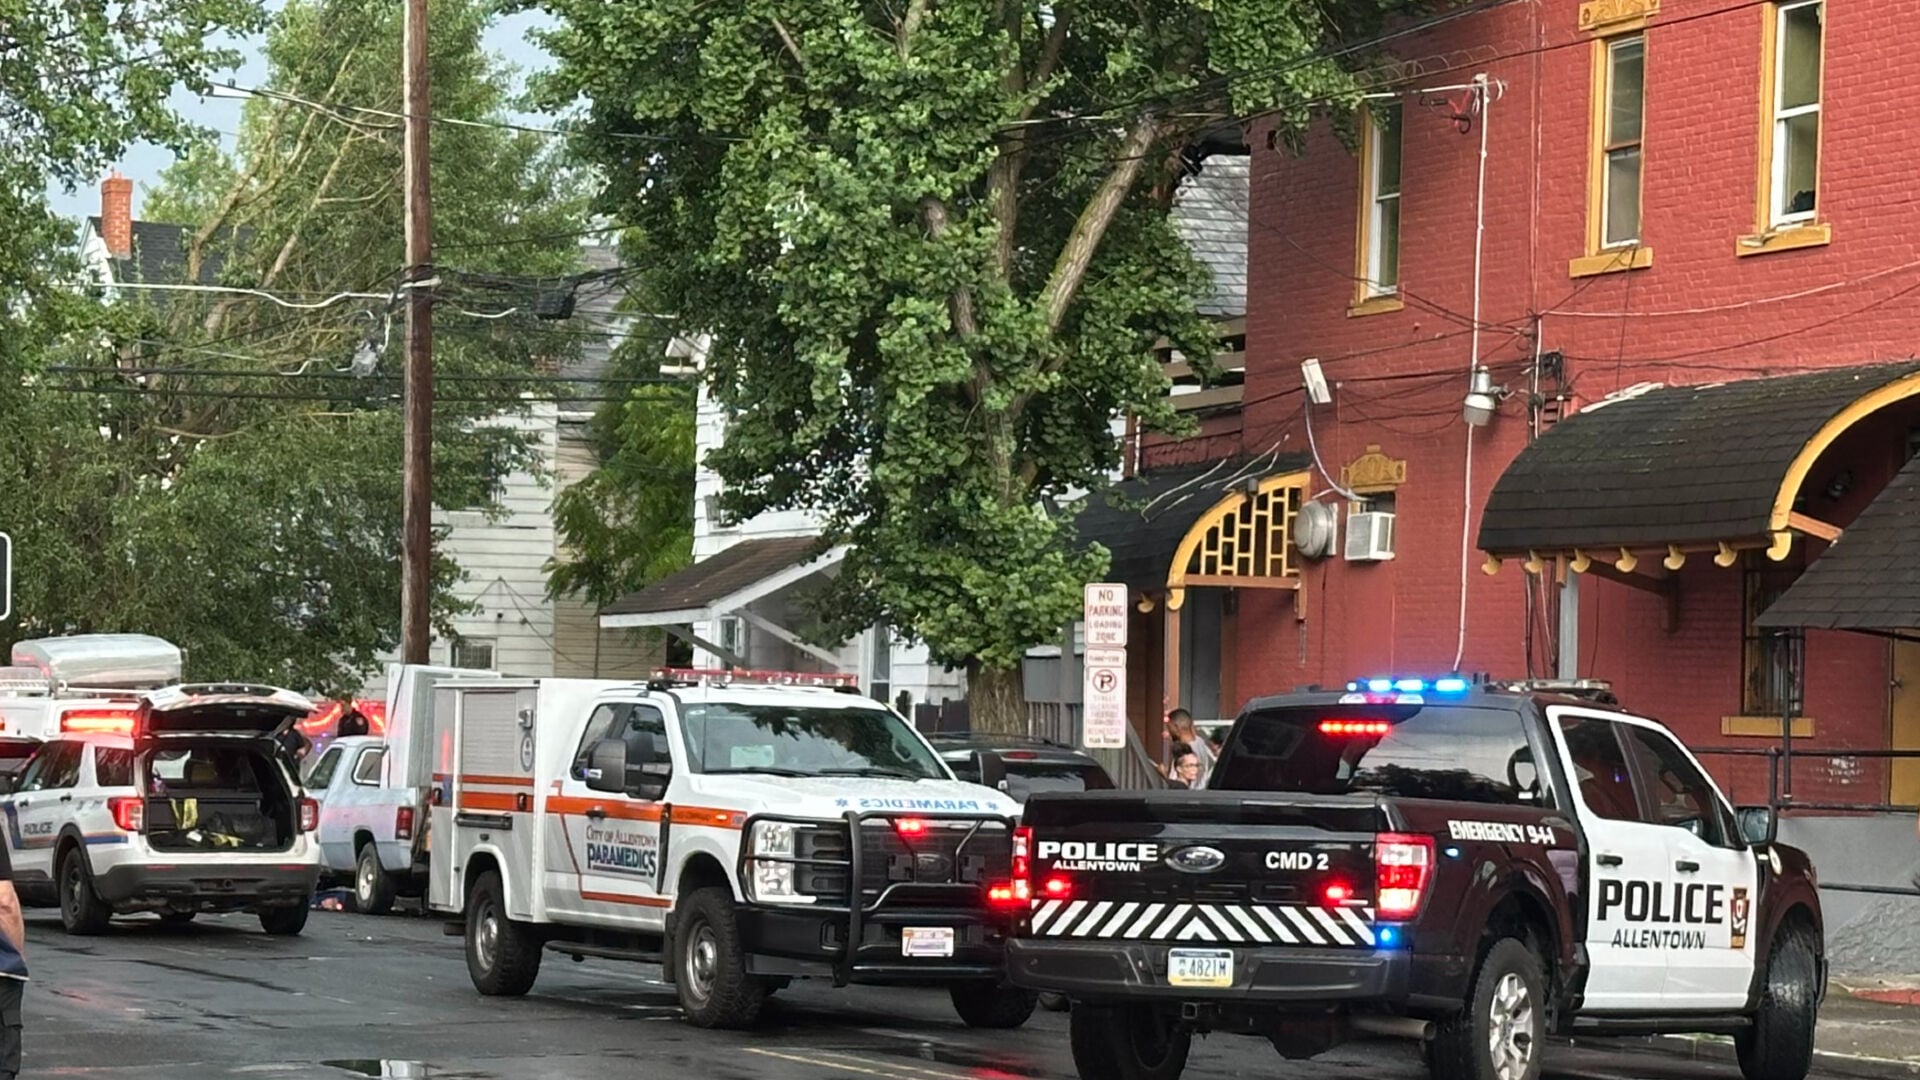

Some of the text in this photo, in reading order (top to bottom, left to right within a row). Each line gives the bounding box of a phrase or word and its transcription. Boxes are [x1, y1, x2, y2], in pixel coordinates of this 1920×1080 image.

[1098, 589, 1114, 602] NO
[1088, 604, 1124, 617] PARKING
[1088, 621, 1123, 629] LOADING
[1095, 631, 1116, 641] ZONE
[24, 821, 54, 835] POLICE
[586, 824, 603, 841] CITY
[614, 830, 658, 848] ALLENTOWN
[1447, 819, 1526, 843] EMERGENCY
[586, 842, 657, 878] PARAMEDICS
[1037, 841, 1159, 862] POLICE
[1265, 851, 1330, 871] CMD 2
[1052, 859, 1141, 872] ALLENTOWN
[1596, 878, 1724, 925] POLICE
[1611, 928, 1706, 950] ALLENTOWN
